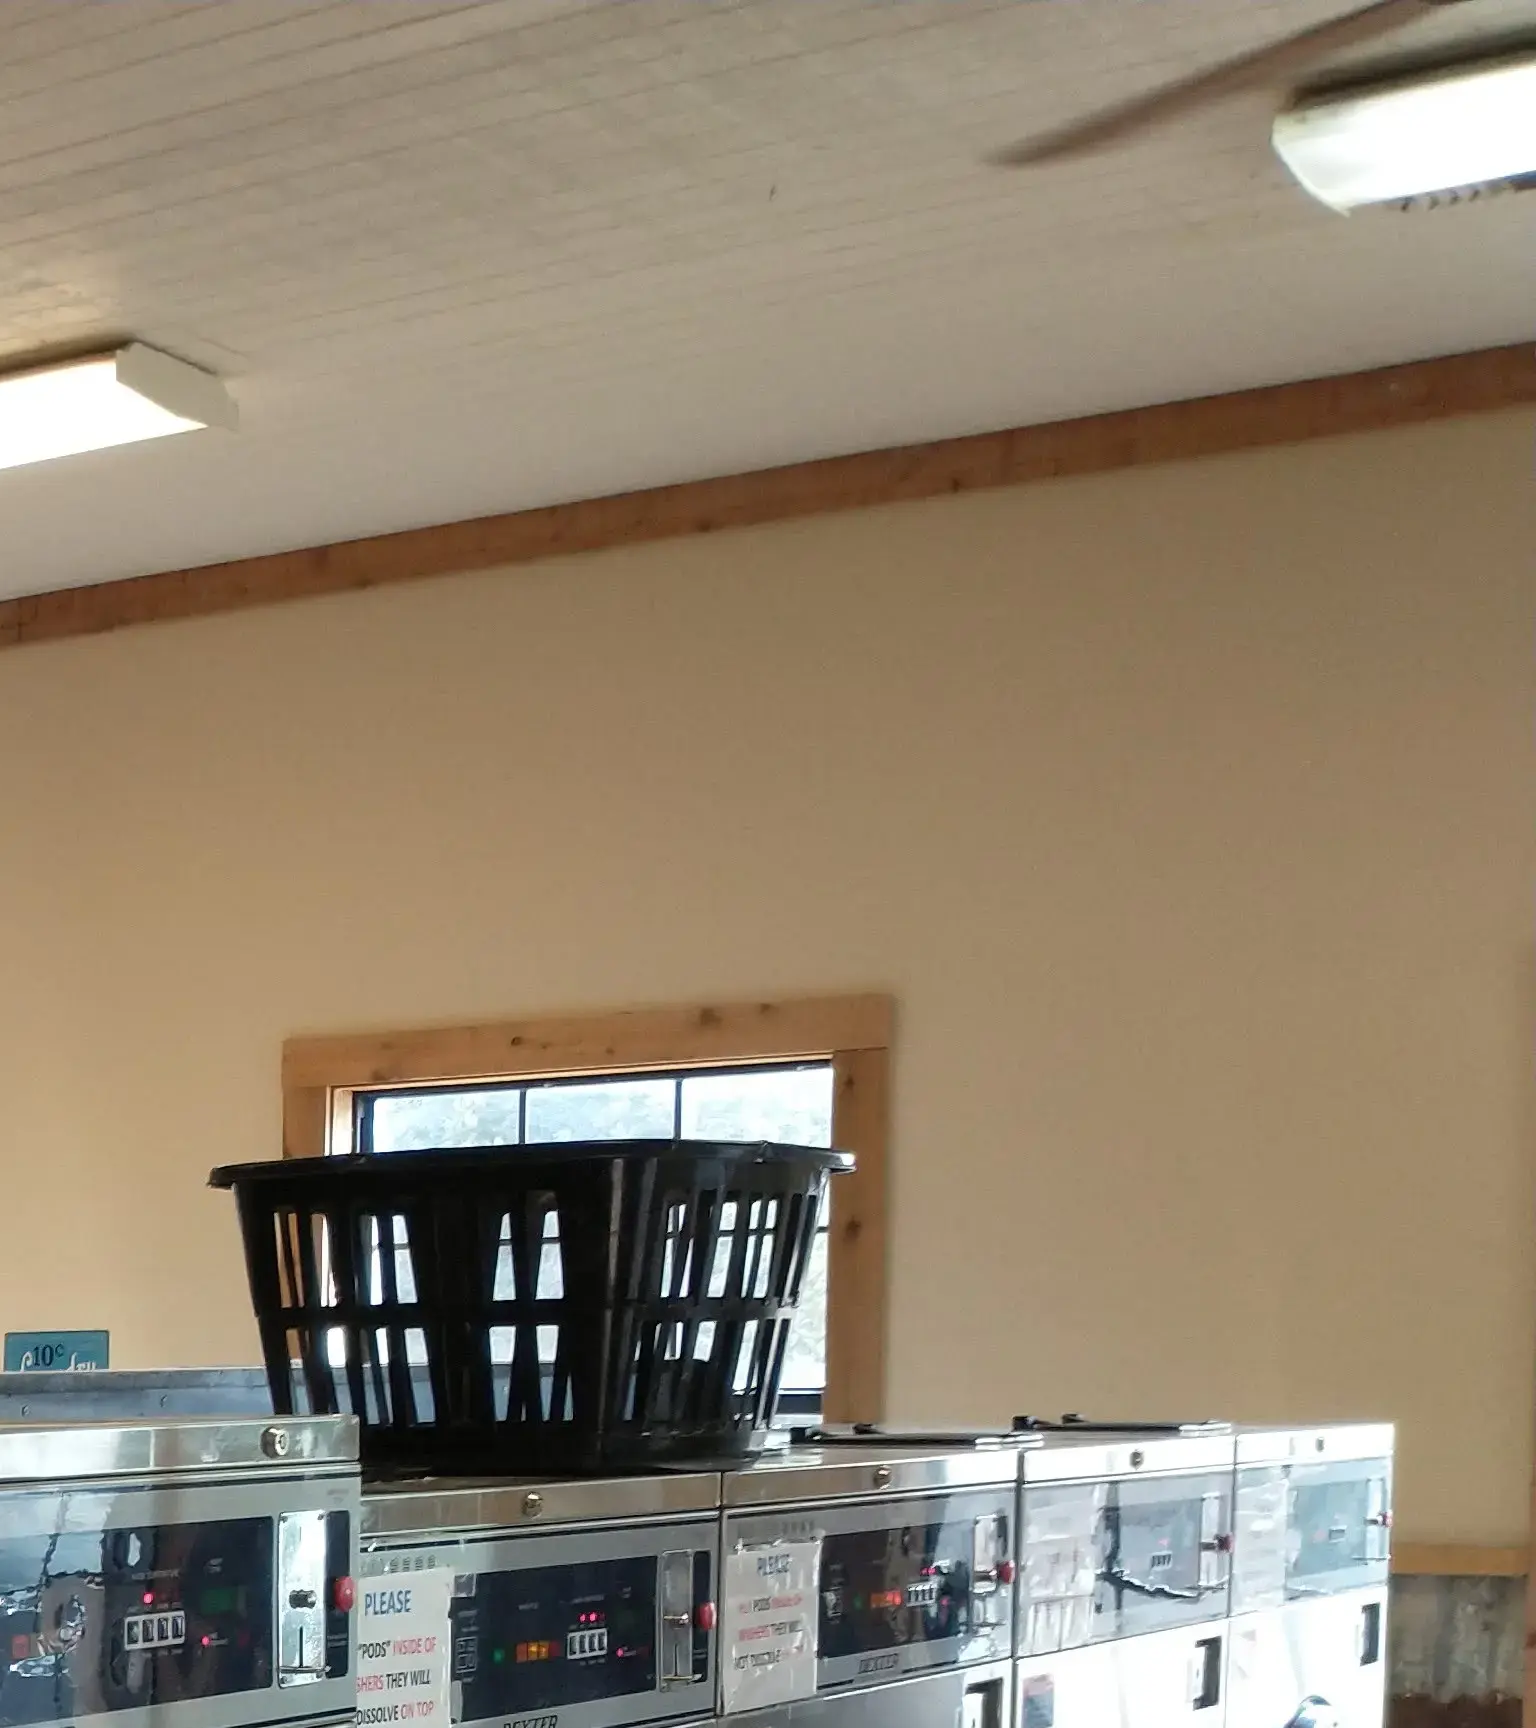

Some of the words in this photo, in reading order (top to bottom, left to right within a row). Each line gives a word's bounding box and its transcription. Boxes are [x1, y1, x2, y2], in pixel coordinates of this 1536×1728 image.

[364, 1589, 412, 1617] PLEASE
[392, 1638, 422, 1654] INSIDE
[424, 1636, 437, 1653] OF
[385, 1671, 409, 1690] THEY
[410, 1668, 431, 1686] WILL
[356, 1704, 399, 1726] DISSOLVE
[400, 1703, 414, 1720] ON
[416, 1700, 434, 1718] TOP
